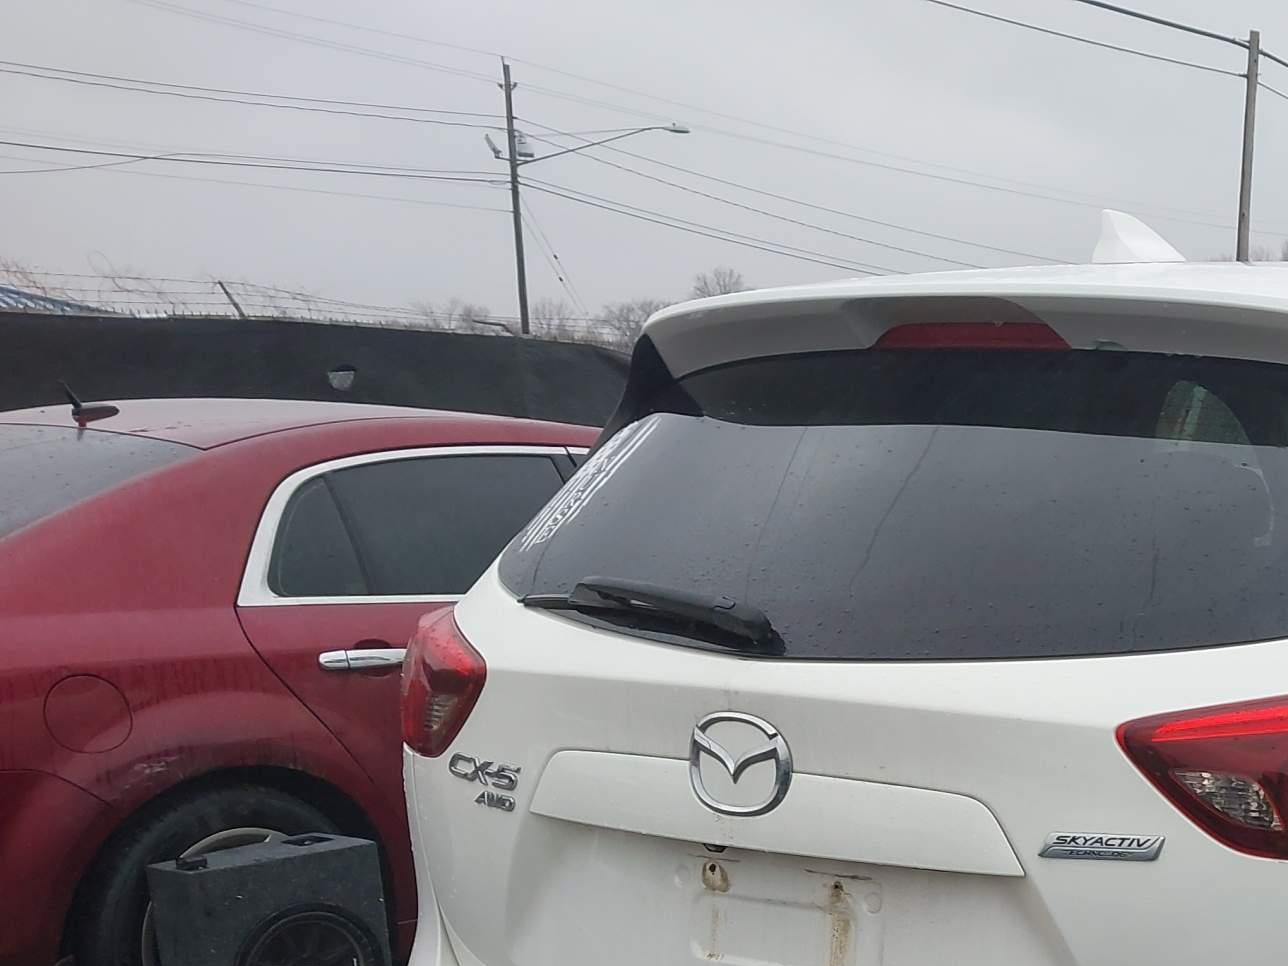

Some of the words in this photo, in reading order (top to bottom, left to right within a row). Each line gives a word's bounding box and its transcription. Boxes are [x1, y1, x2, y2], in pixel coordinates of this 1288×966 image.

[449, 752, 521, 791] CX-5
[474, 791, 516, 812] AWD
[1052, 835, 1151, 848] SKYACTIV
